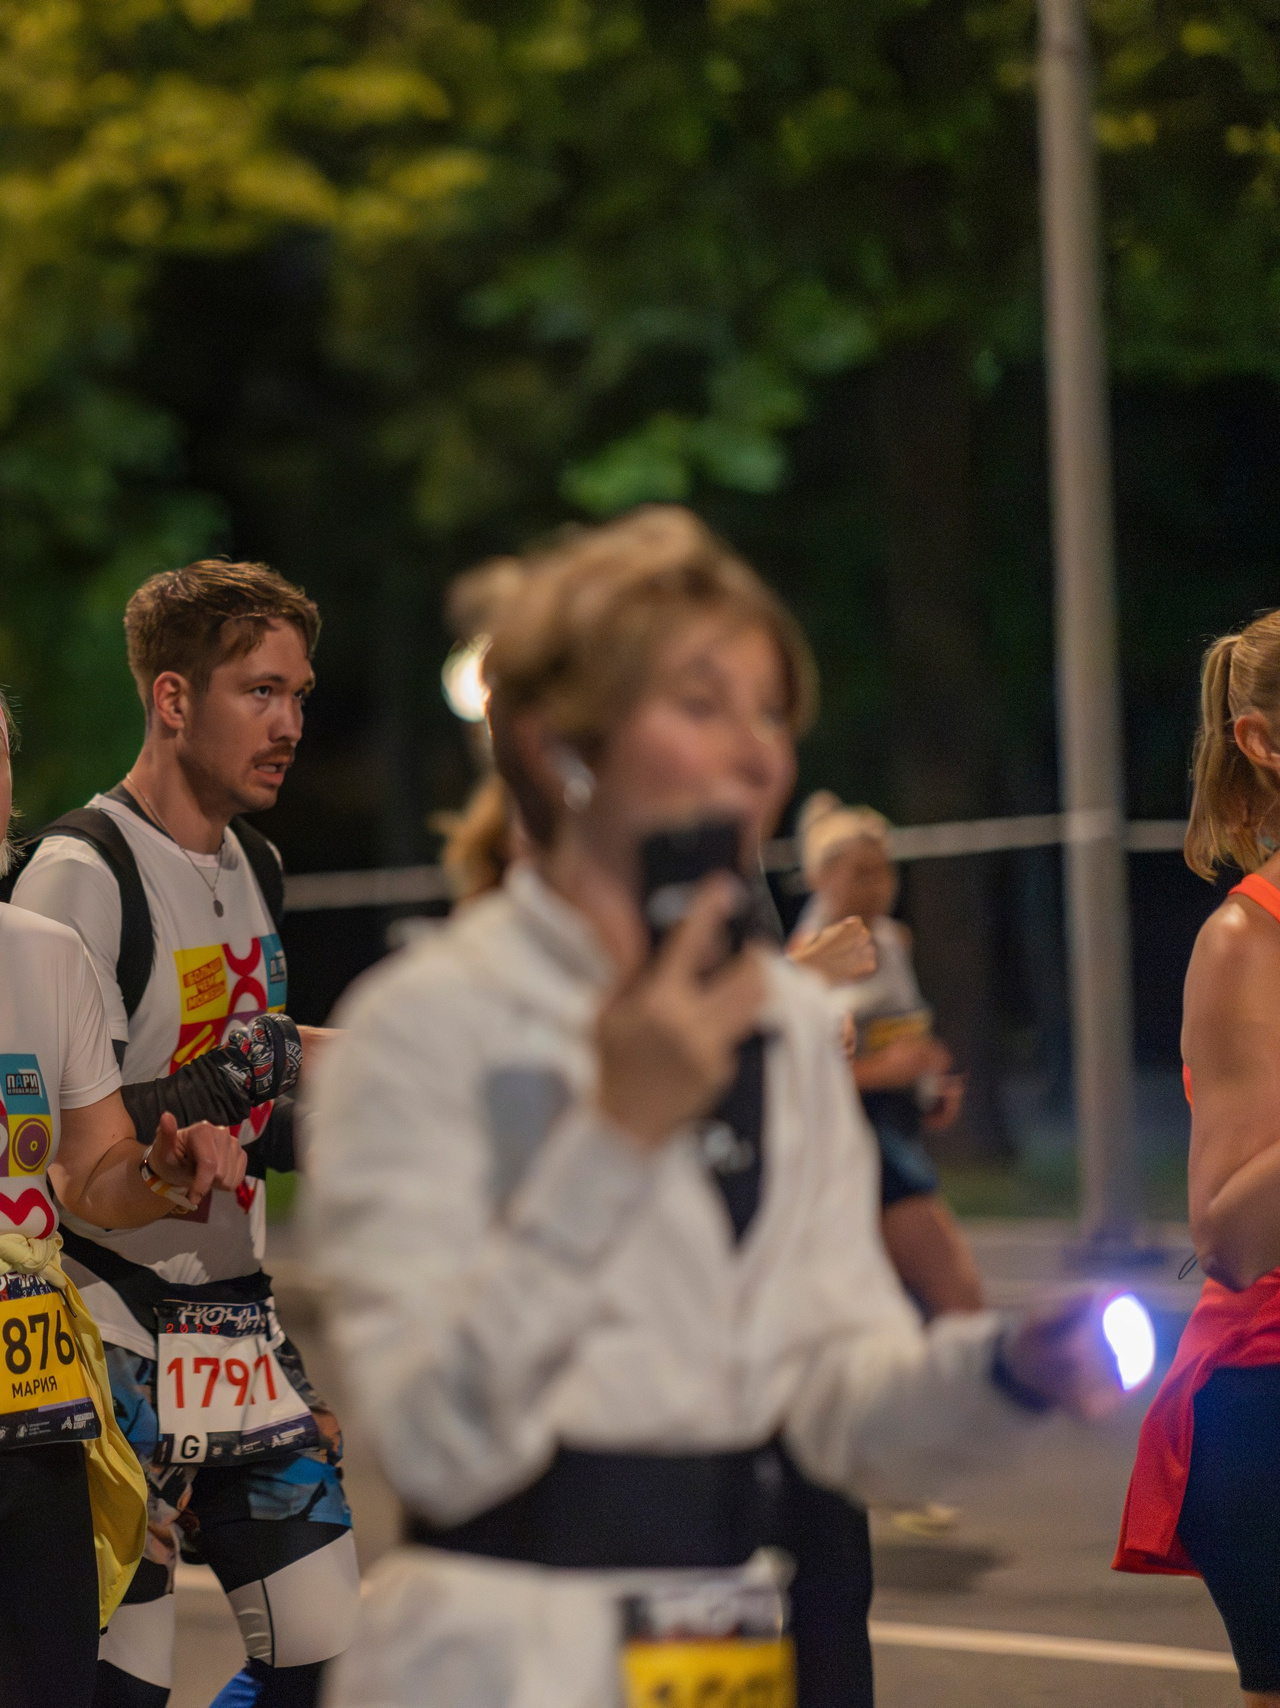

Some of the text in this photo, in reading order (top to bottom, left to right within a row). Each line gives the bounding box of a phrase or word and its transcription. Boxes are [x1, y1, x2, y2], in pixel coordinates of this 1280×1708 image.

[7, 1074, 38, 1089] ПАРИ
[11, 1375, 58, 1399] МАРИЯ
[166, 1353, 278, 1409] 1791
[180, 1434, 201, 1460] G
